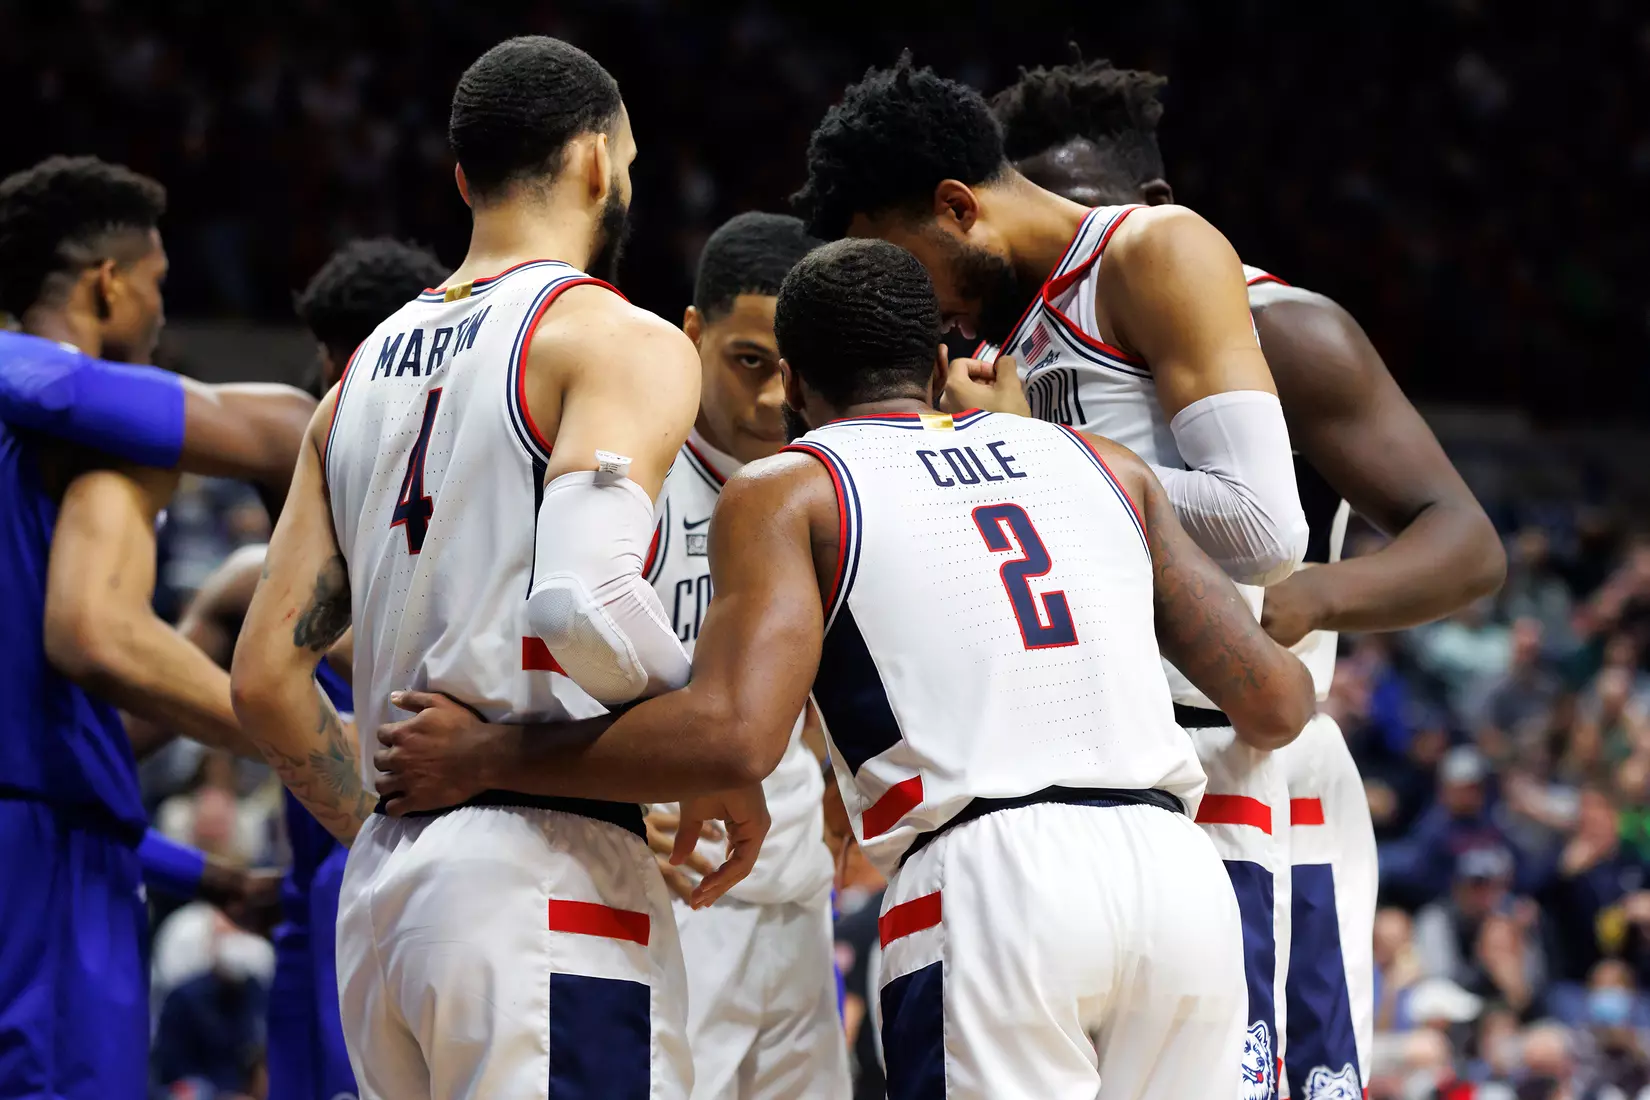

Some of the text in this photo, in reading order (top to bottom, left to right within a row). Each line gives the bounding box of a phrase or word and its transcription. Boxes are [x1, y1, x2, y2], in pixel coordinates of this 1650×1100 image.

[371, 305, 492, 381] MARTIN
[390, 386, 443, 555] 4
[916, 440, 1027, 487] COLE
[971, 502, 1079, 650] 2
